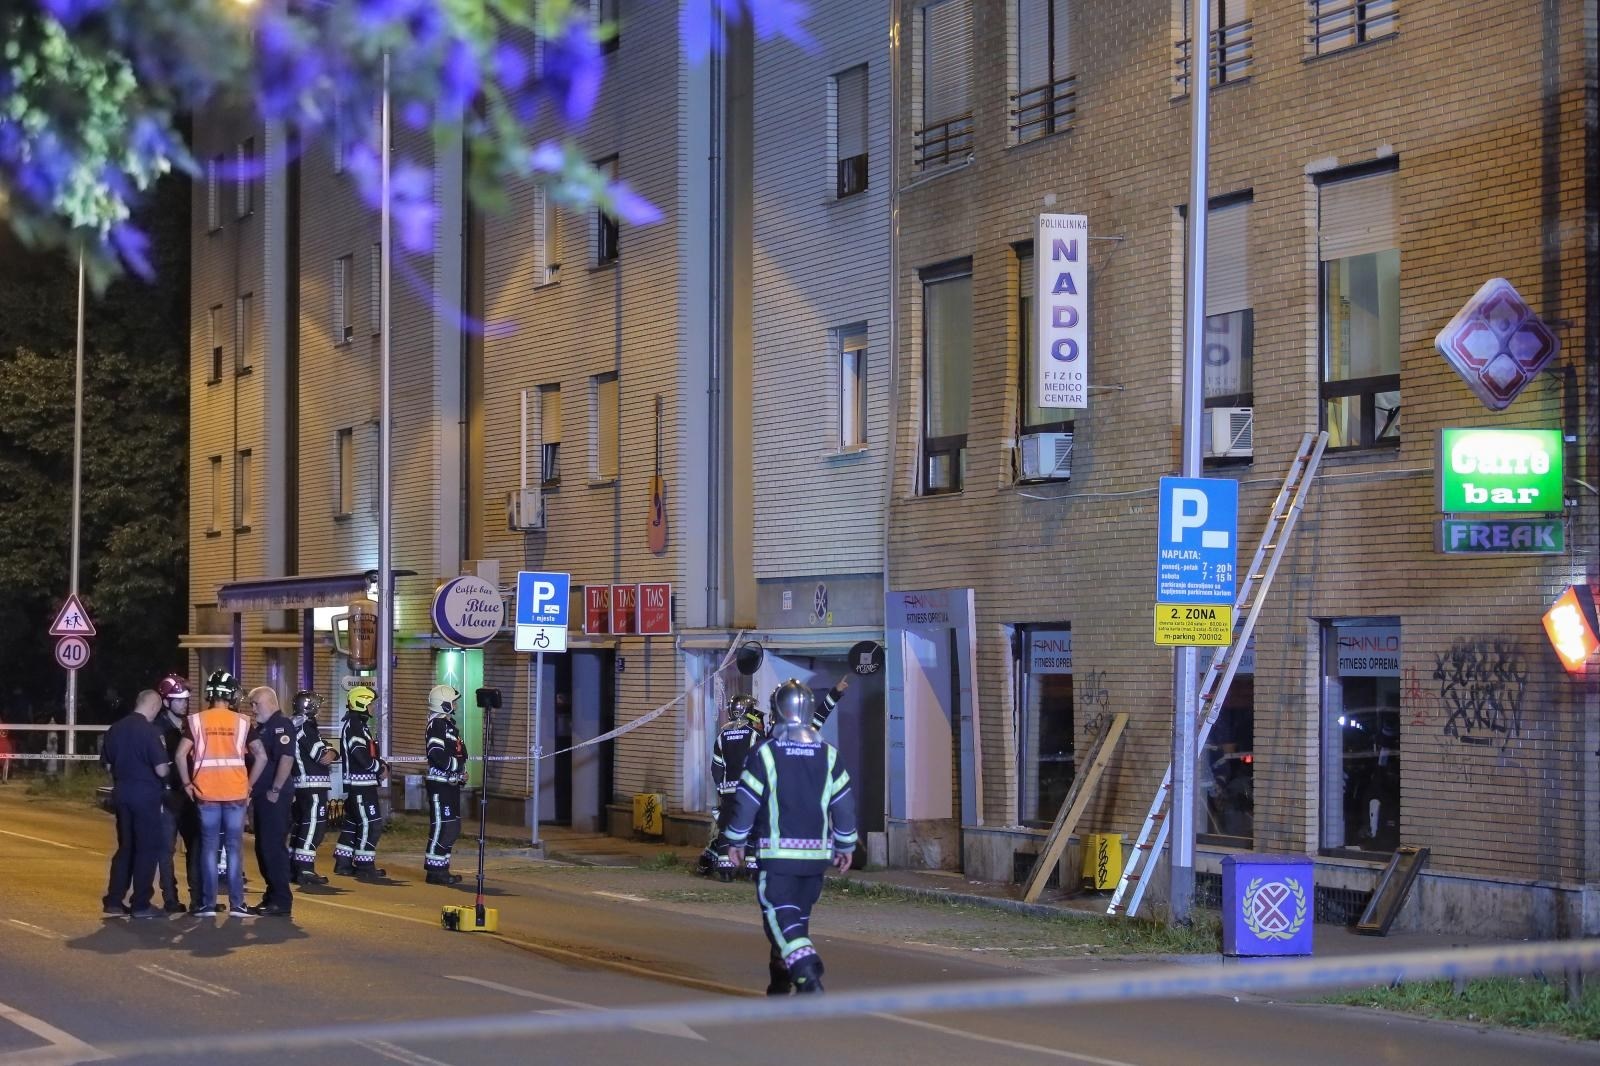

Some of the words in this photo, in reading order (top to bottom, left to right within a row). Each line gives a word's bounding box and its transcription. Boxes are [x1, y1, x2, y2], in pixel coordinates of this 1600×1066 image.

[1040, 218, 1087, 229] POLIKLINIKA
[1051, 238, 1079, 362] NADO
[1044, 372, 1082, 381] FIZIO
[1044, 383, 1082, 392] MEDICO
[1044, 394, 1082, 403] CENTAR
[1463, 483, 1539, 504] bar
[1171, 488, 1208, 543] P
[1451, 525, 1555, 549] FREAK
[1161, 549, 1201, 560] NAPLATA:
[1202, 562, 1208, 571] 7
[1216, 564, 1226, 573] 20
[1227, 563, 1232, 571] h
[1202, 572, 1208, 580] 7
[1216, 574, 1225, 583] 15
[1227, 573, 1232, 581] h
[455, 585, 478, 595] Caffe
[479, 585, 493, 595] bar
[532, 581, 555, 614] P
[618, 588, 635, 608] TMS
[646, 588, 664, 607] TMS
[465, 599, 500, 613] Blue
[906, 613, 927, 624] FITNESS
[1171, 608, 1181, 619] 2.
[1186, 609, 1216, 619] ZONA
[455, 613, 496, 627] Moon
[1164, 633, 1196, 642] m-parking
[62, 644, 82, 661] 40
[1034, 657, 1055, 668] FITNESS
[1339, 658, 1367, 669] FITNESS
[1369, 658, 1399, 669] OPREMA
